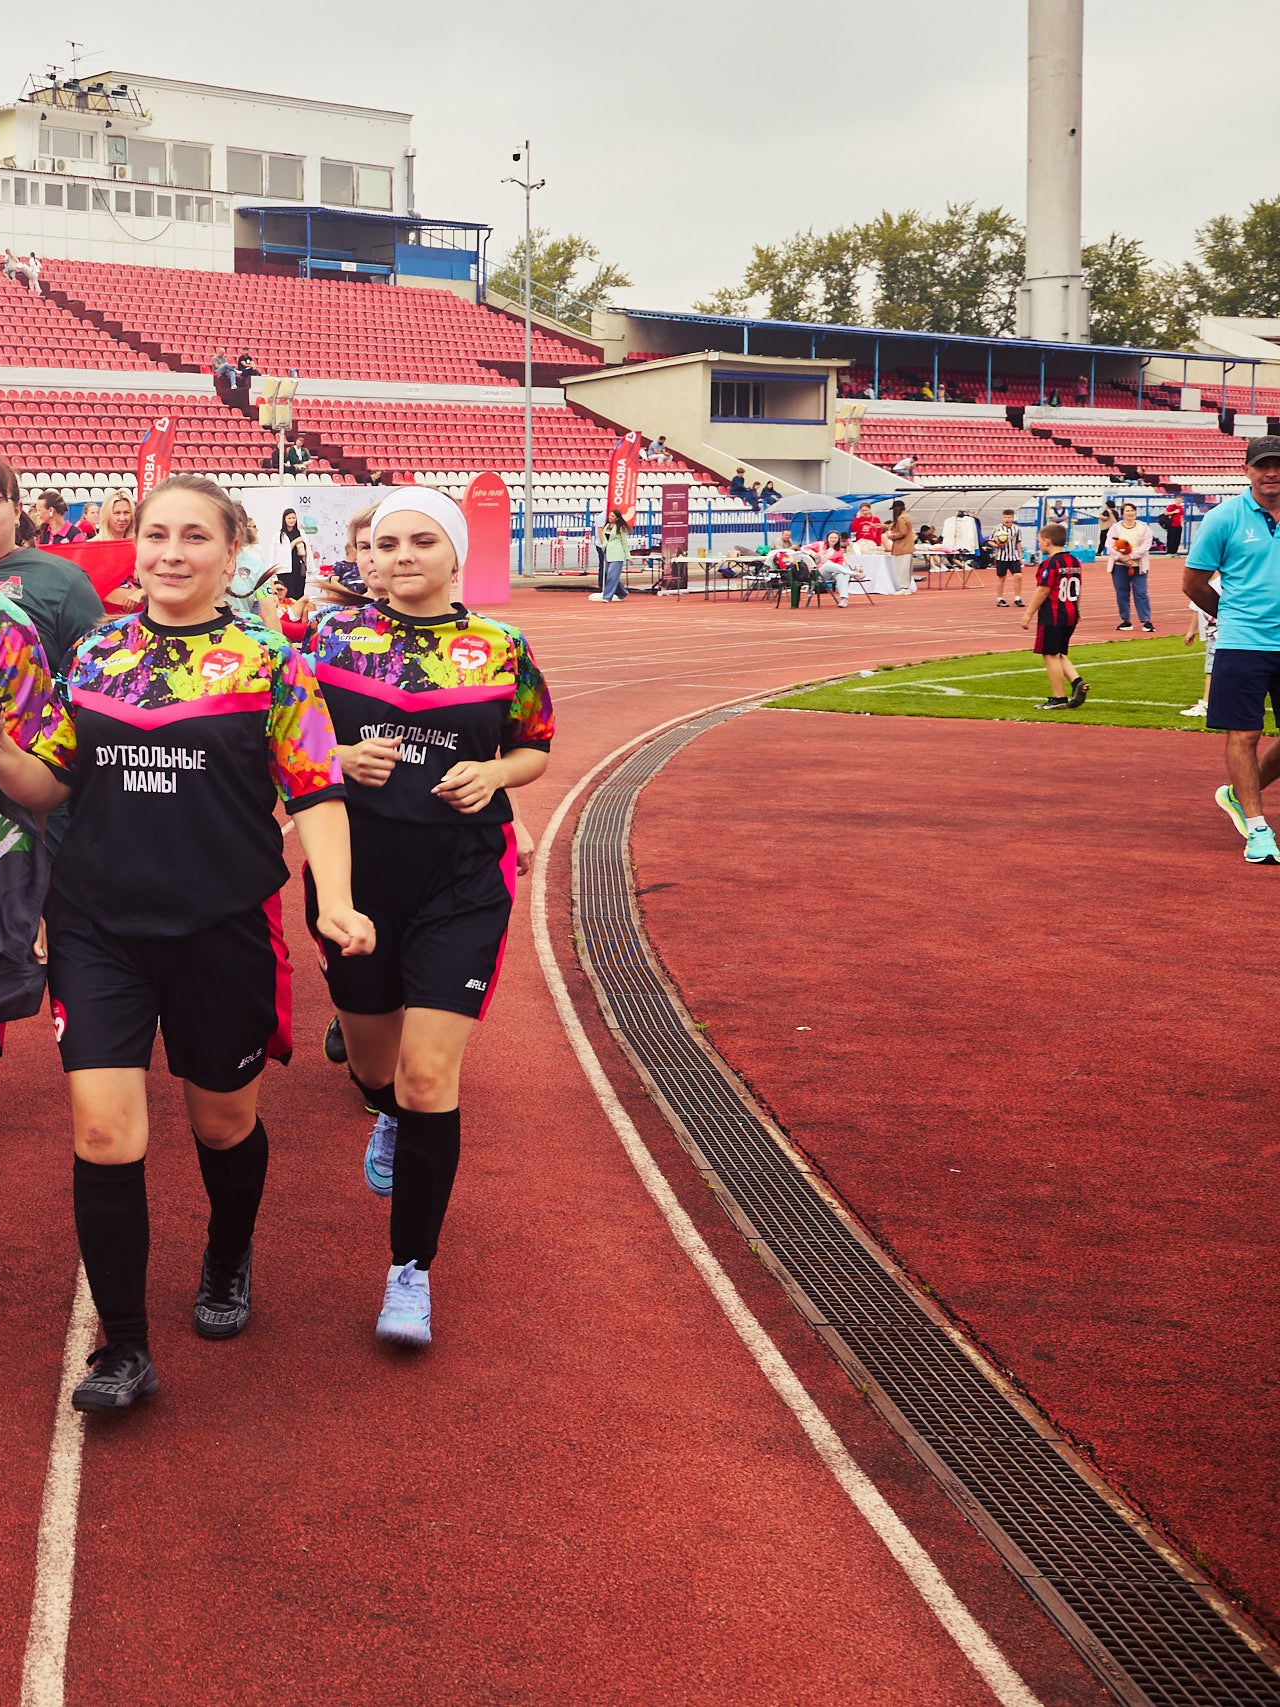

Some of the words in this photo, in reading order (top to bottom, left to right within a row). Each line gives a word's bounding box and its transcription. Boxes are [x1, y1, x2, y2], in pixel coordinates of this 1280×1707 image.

[142, 453, 156, 499] НОВА
[614, 458, 627, 505] ОСНОВА
[1058, 576, 1081, 602] 80
[451, 647, 487, 669] 52
[201, 661, 240, 683] 52
[96, 745, 207, 770] ФУТБОЛЬНЫЕ
[395, 742, 427, 765] МЫ
[123, 769, 177, 794] МАМЫ
